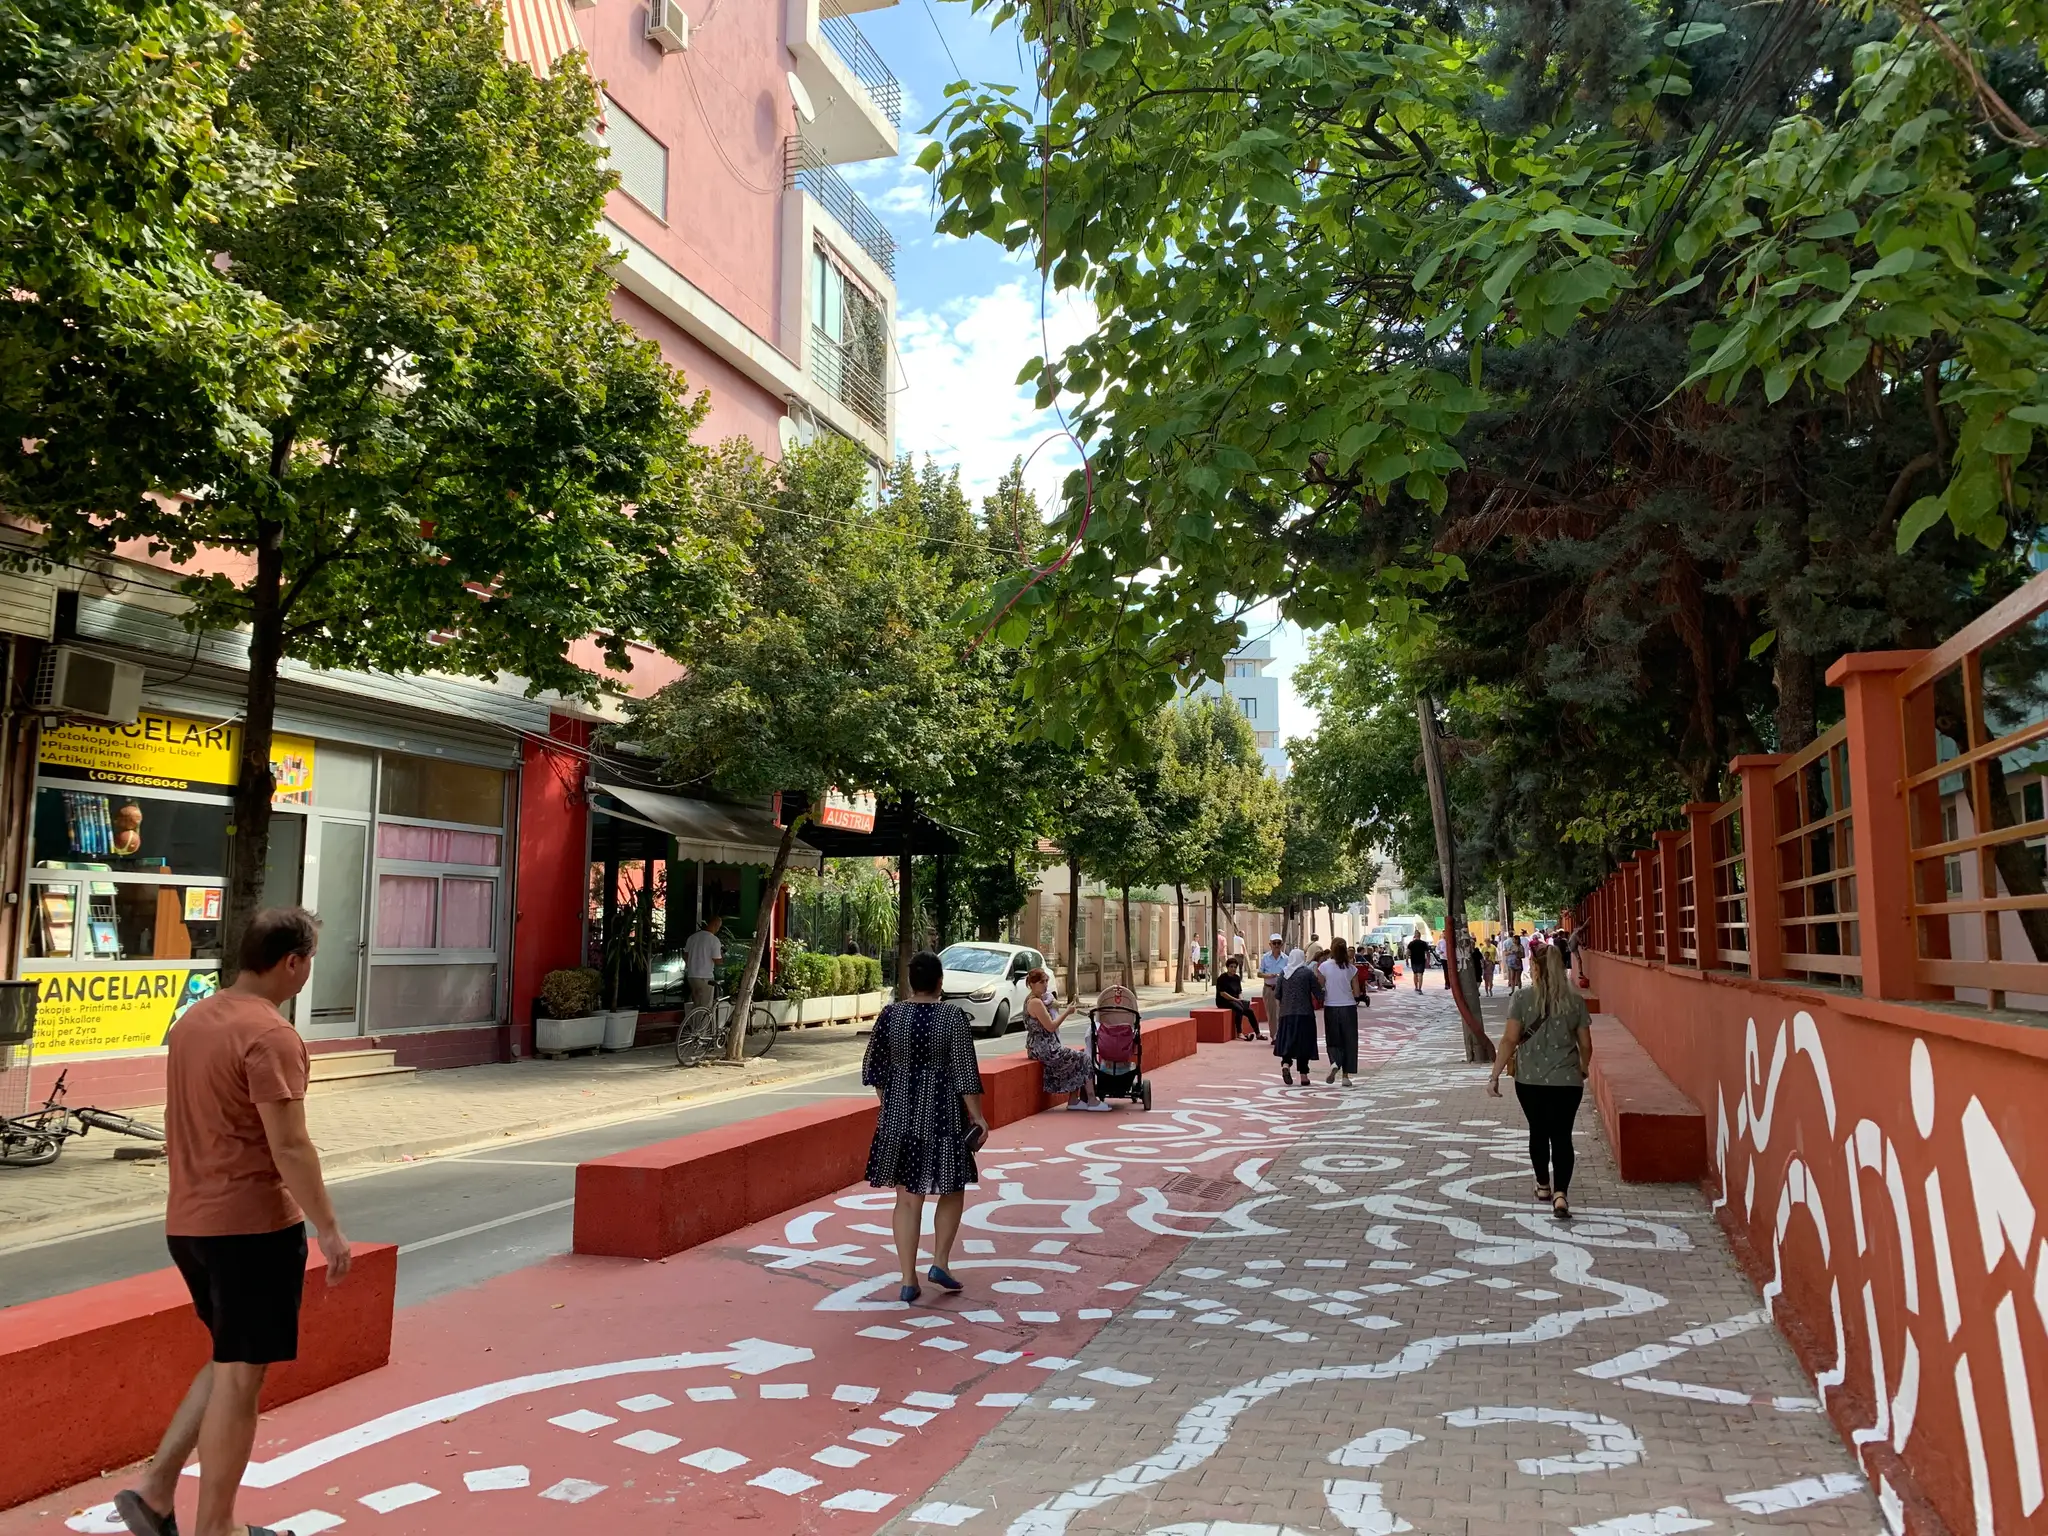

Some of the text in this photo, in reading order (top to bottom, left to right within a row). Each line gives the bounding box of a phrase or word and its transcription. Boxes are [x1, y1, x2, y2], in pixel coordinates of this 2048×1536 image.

[49, 730, 165, 754] Fotokopje-Lidhje
[58, 717, 232, 751] CELARI
[48, 741, 131, 760] Plastifikime
[46, 752, 154, 773] Artikuj shkollor
[97, 771, 188, 790] 0675656045
[826, 811, 871, 830] AUSTRIA
[25, 974, 177, 1004] ANCELARI
[37, 1004, 71, 1016] okopje
[80, 1003, 118, 1013] Printime
[120, 1002, 132, 1011] A3
[140, 1002, 151, 1010] A4
[33, 1026, 97, 1038] tikuj per Zyra
[49, 1037, 66, 1048] dhe
[69, 1035, 103, 1046] Revista
[105, 1035, 120, 1046] per
